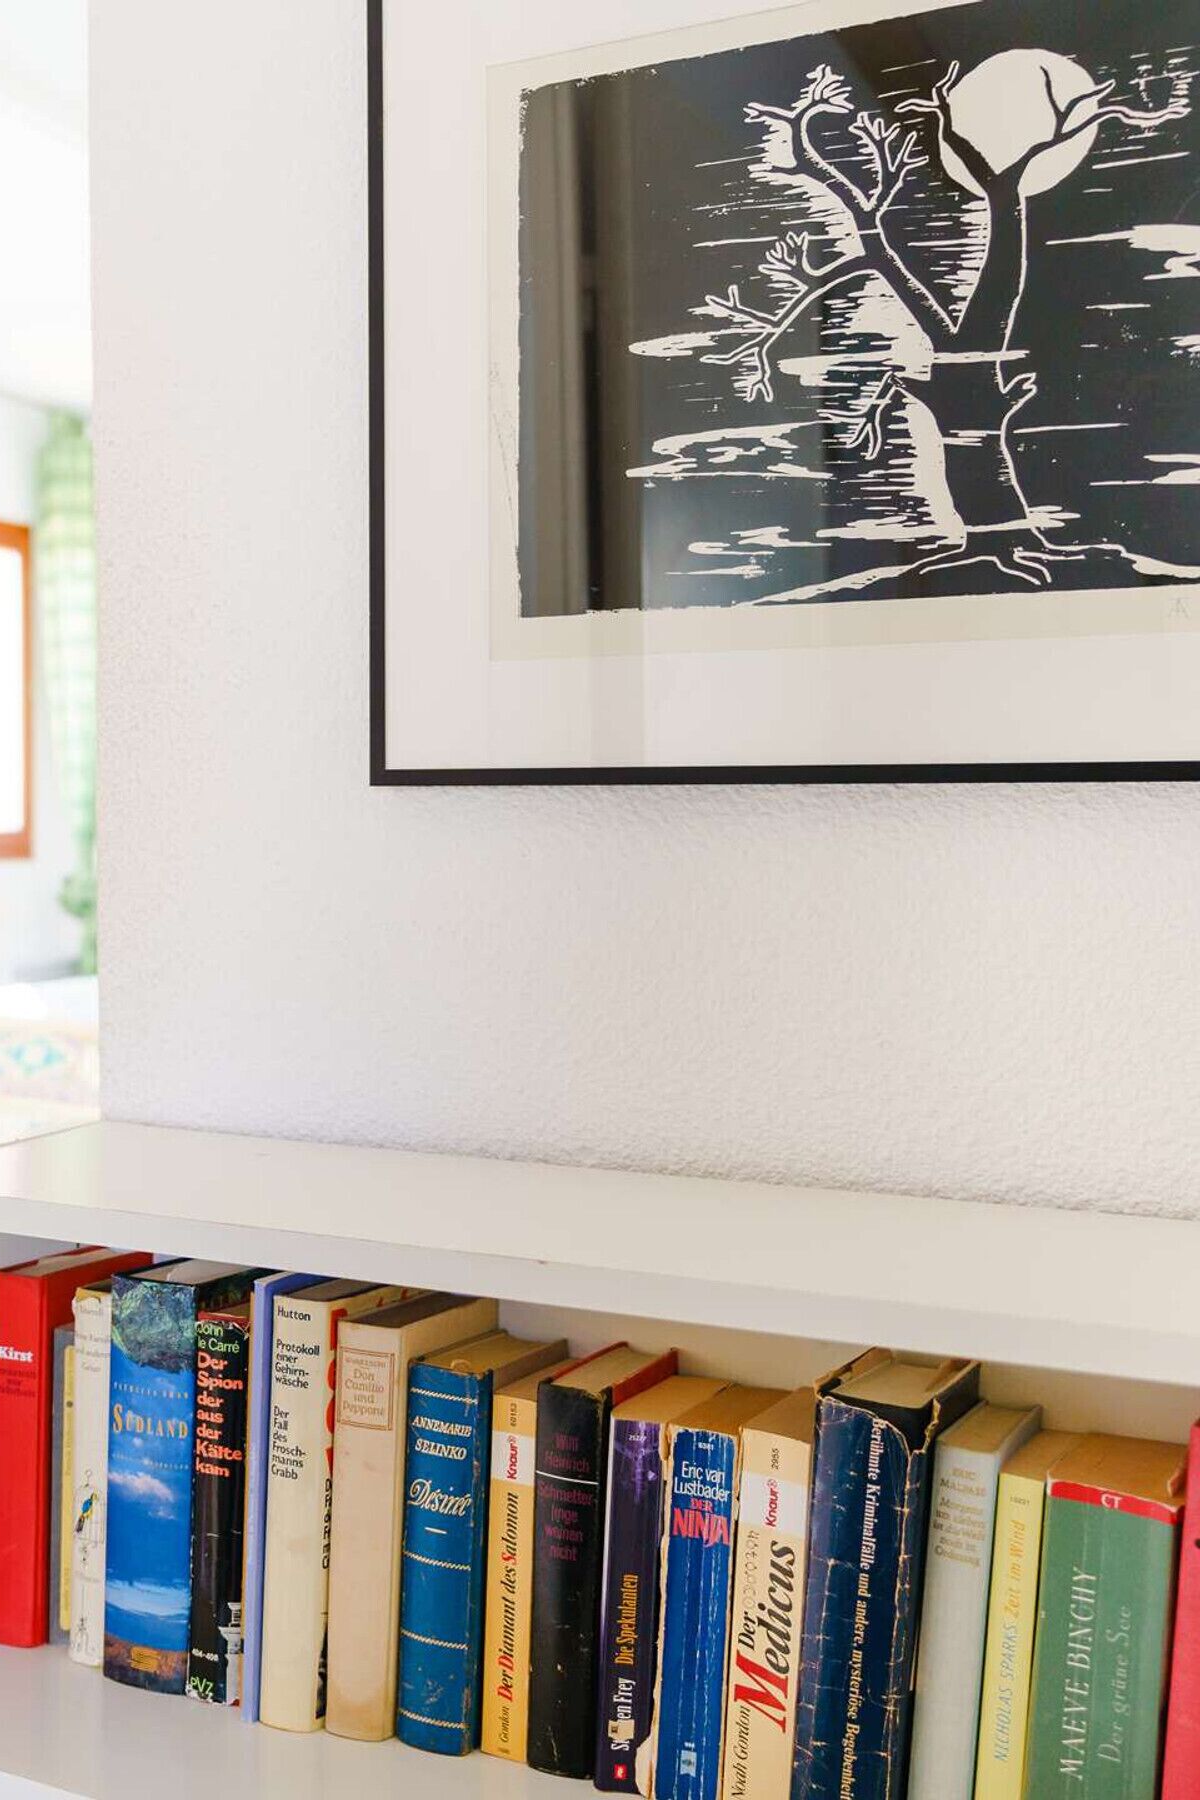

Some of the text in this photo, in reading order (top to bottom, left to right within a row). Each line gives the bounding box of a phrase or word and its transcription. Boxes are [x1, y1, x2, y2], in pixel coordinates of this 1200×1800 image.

[277, 1306, 311, 1322] Hutton
[208, 1337, 240, 1354] Carré
[276, 1338, 320, 1356] Protokoll
[197, 1351, 229, 1370] Der
[275, 1361, 310, 1377] Gehirn-
[276, 1353, 298, 1364] einer
[197, 1370, 243, 1390] Spion
[275, 1373, 309, 1389] wäsche
[196, 1390, 224, 1409] der
[196, 1409, 224, 1424] aus
[273, 1417, 288, 1431] Fall
[274, 1406, 289, 1419] Der
[196, 1423, 222, 1441] der
[272, 1430, 287, 1443] des
[412, 1415, 472, 1438] ANNEMARIE
[195, 1439, 243, 1462] Kälte
[272, 1441, 306, 1457] Frosch-
[415, 1438, 467, 1460] SELINKO
[867, 1418, 886, 1480] Berühmte
[195, 1459, 230, 1478] kam
[271, 1463, 298, 1480] Crabb
[272, 1454, 304, 1468] manns
[681, 1461, 725, 1485] Eric van
[674, 1477, 730, 1502] Lustbader
[690, 1499, 713, 1514] DER
[1100, 1493, 1123, 1510] CT
[501, 1492, 520, 1565] Salomon
[672, 1508, 730, 1547] NINJA
[860, 1483, 881, 1570] Kriminalfälle
[500, 1565, 517, 1594] des
[858, 1572, 872, 1598] und
[614, 1573, 639, 1667] Die Spekulanten
[738, 1610, 756, 1651] Der
[496, 1597, 516, 1672] Diamant
[734, 1540, 796, 1734] Medicus
[1000, 1619, 1018, 1681] SPARKS
[847, 1649, 865, 1719] mysteriöse
[1059, 1566, 1097, 1781] MAEVE BINCHY
[1097, 1606, 1132, 1763] Der grüne See
[496, 1672, 514, 1702] Der
[613, 1677, 636, 1703] Frey
[993, 1687, 1013, 1762] NICHOLAS
[731, 1705, 751, 1799] Noah Gordon
